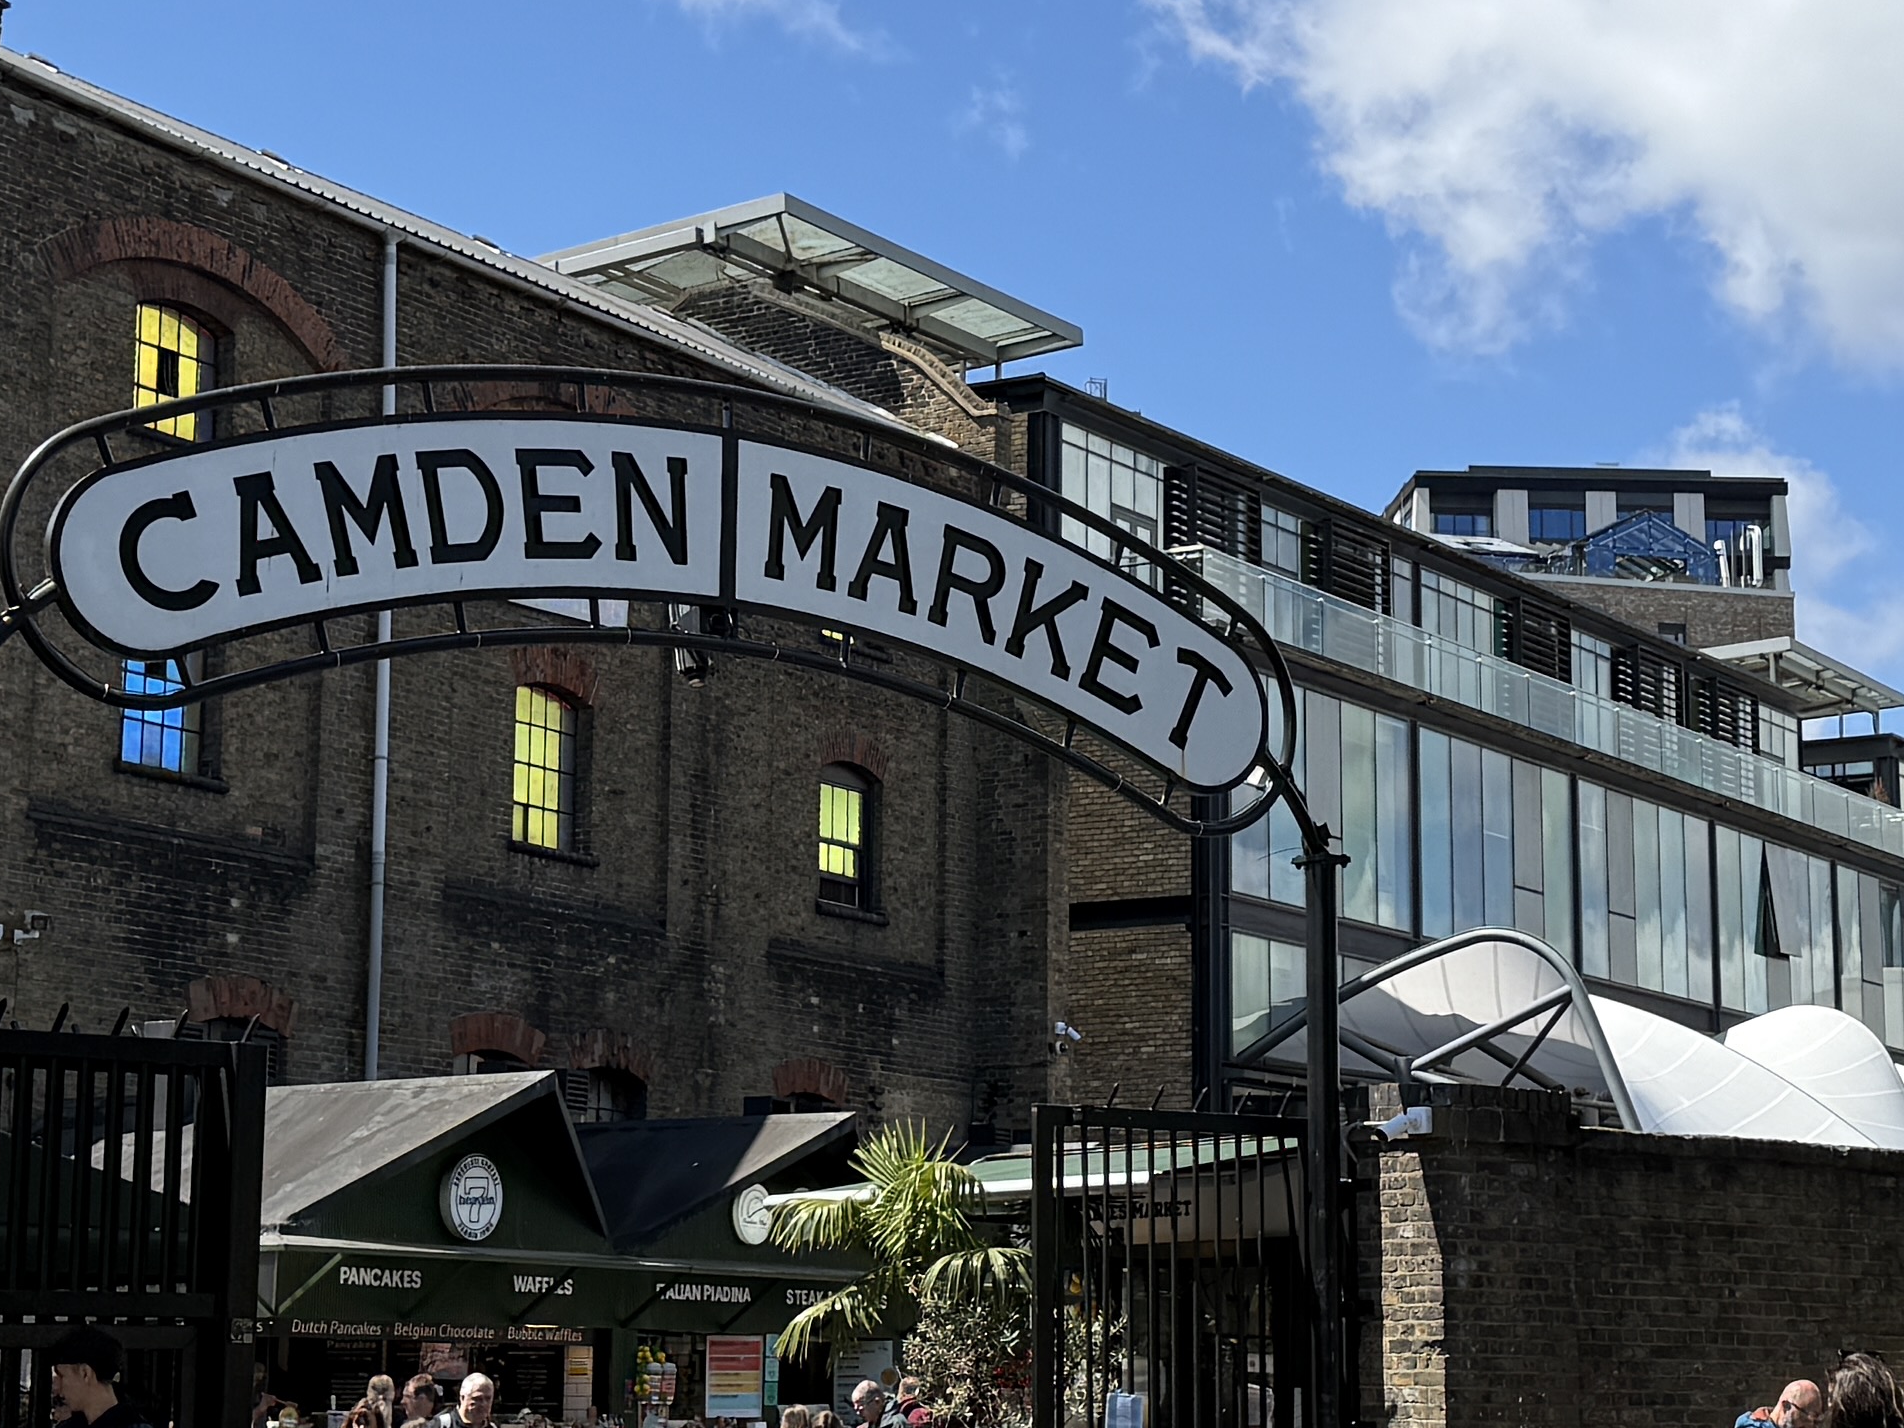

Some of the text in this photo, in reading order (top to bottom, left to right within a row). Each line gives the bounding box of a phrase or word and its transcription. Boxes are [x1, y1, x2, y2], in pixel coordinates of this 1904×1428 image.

[118, 447, 1236, 751] CAMDEN MARKET
[339, 1266, 423, 1289] PANCAKES
[703, 1285, 752, 1303] PIADINA
[291, 1318, 327, 1334] Dutch
[330, 1322, 382, 1336] Pancakes
[394, 1323, 437, 1341] Belgian
[439, 1323, 495, 1339] Chocolate
[507, 1327, 543, 1341] Bubble
